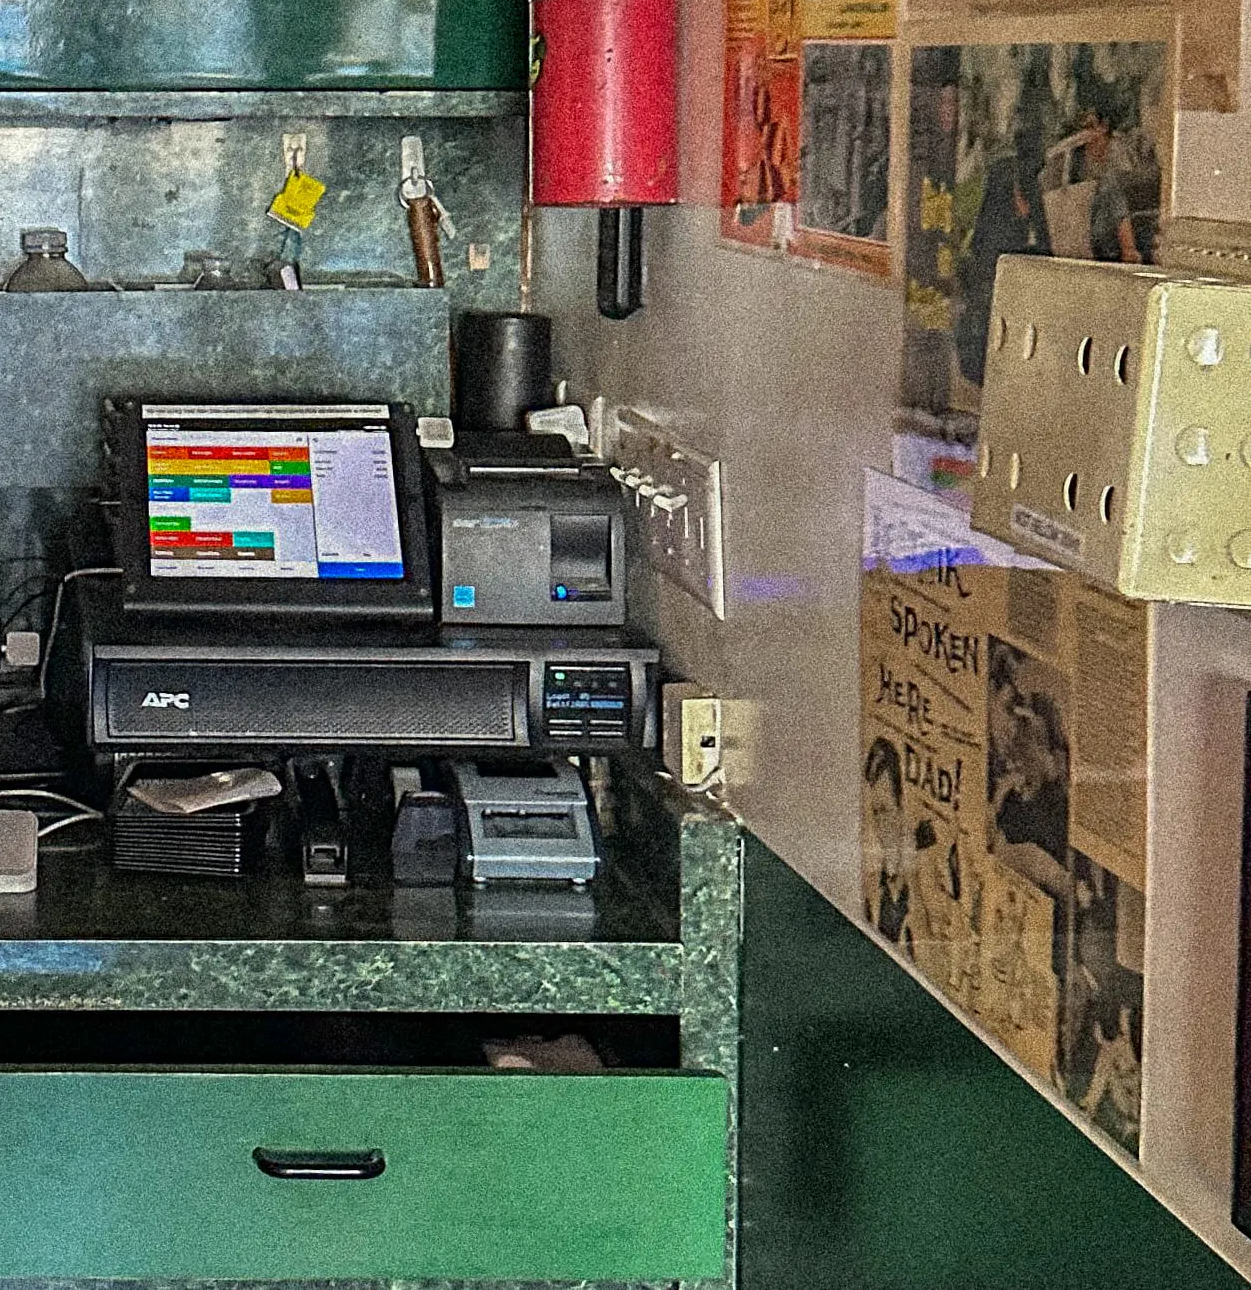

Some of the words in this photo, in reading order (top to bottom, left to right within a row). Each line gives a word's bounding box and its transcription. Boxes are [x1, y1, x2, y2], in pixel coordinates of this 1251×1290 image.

[890, 595, 980, 675] SPOKEN
[141, 692, 190, 709] APC
[875, 663, 935, 736] HERE
[903, 742, 963, 812] DAD!
